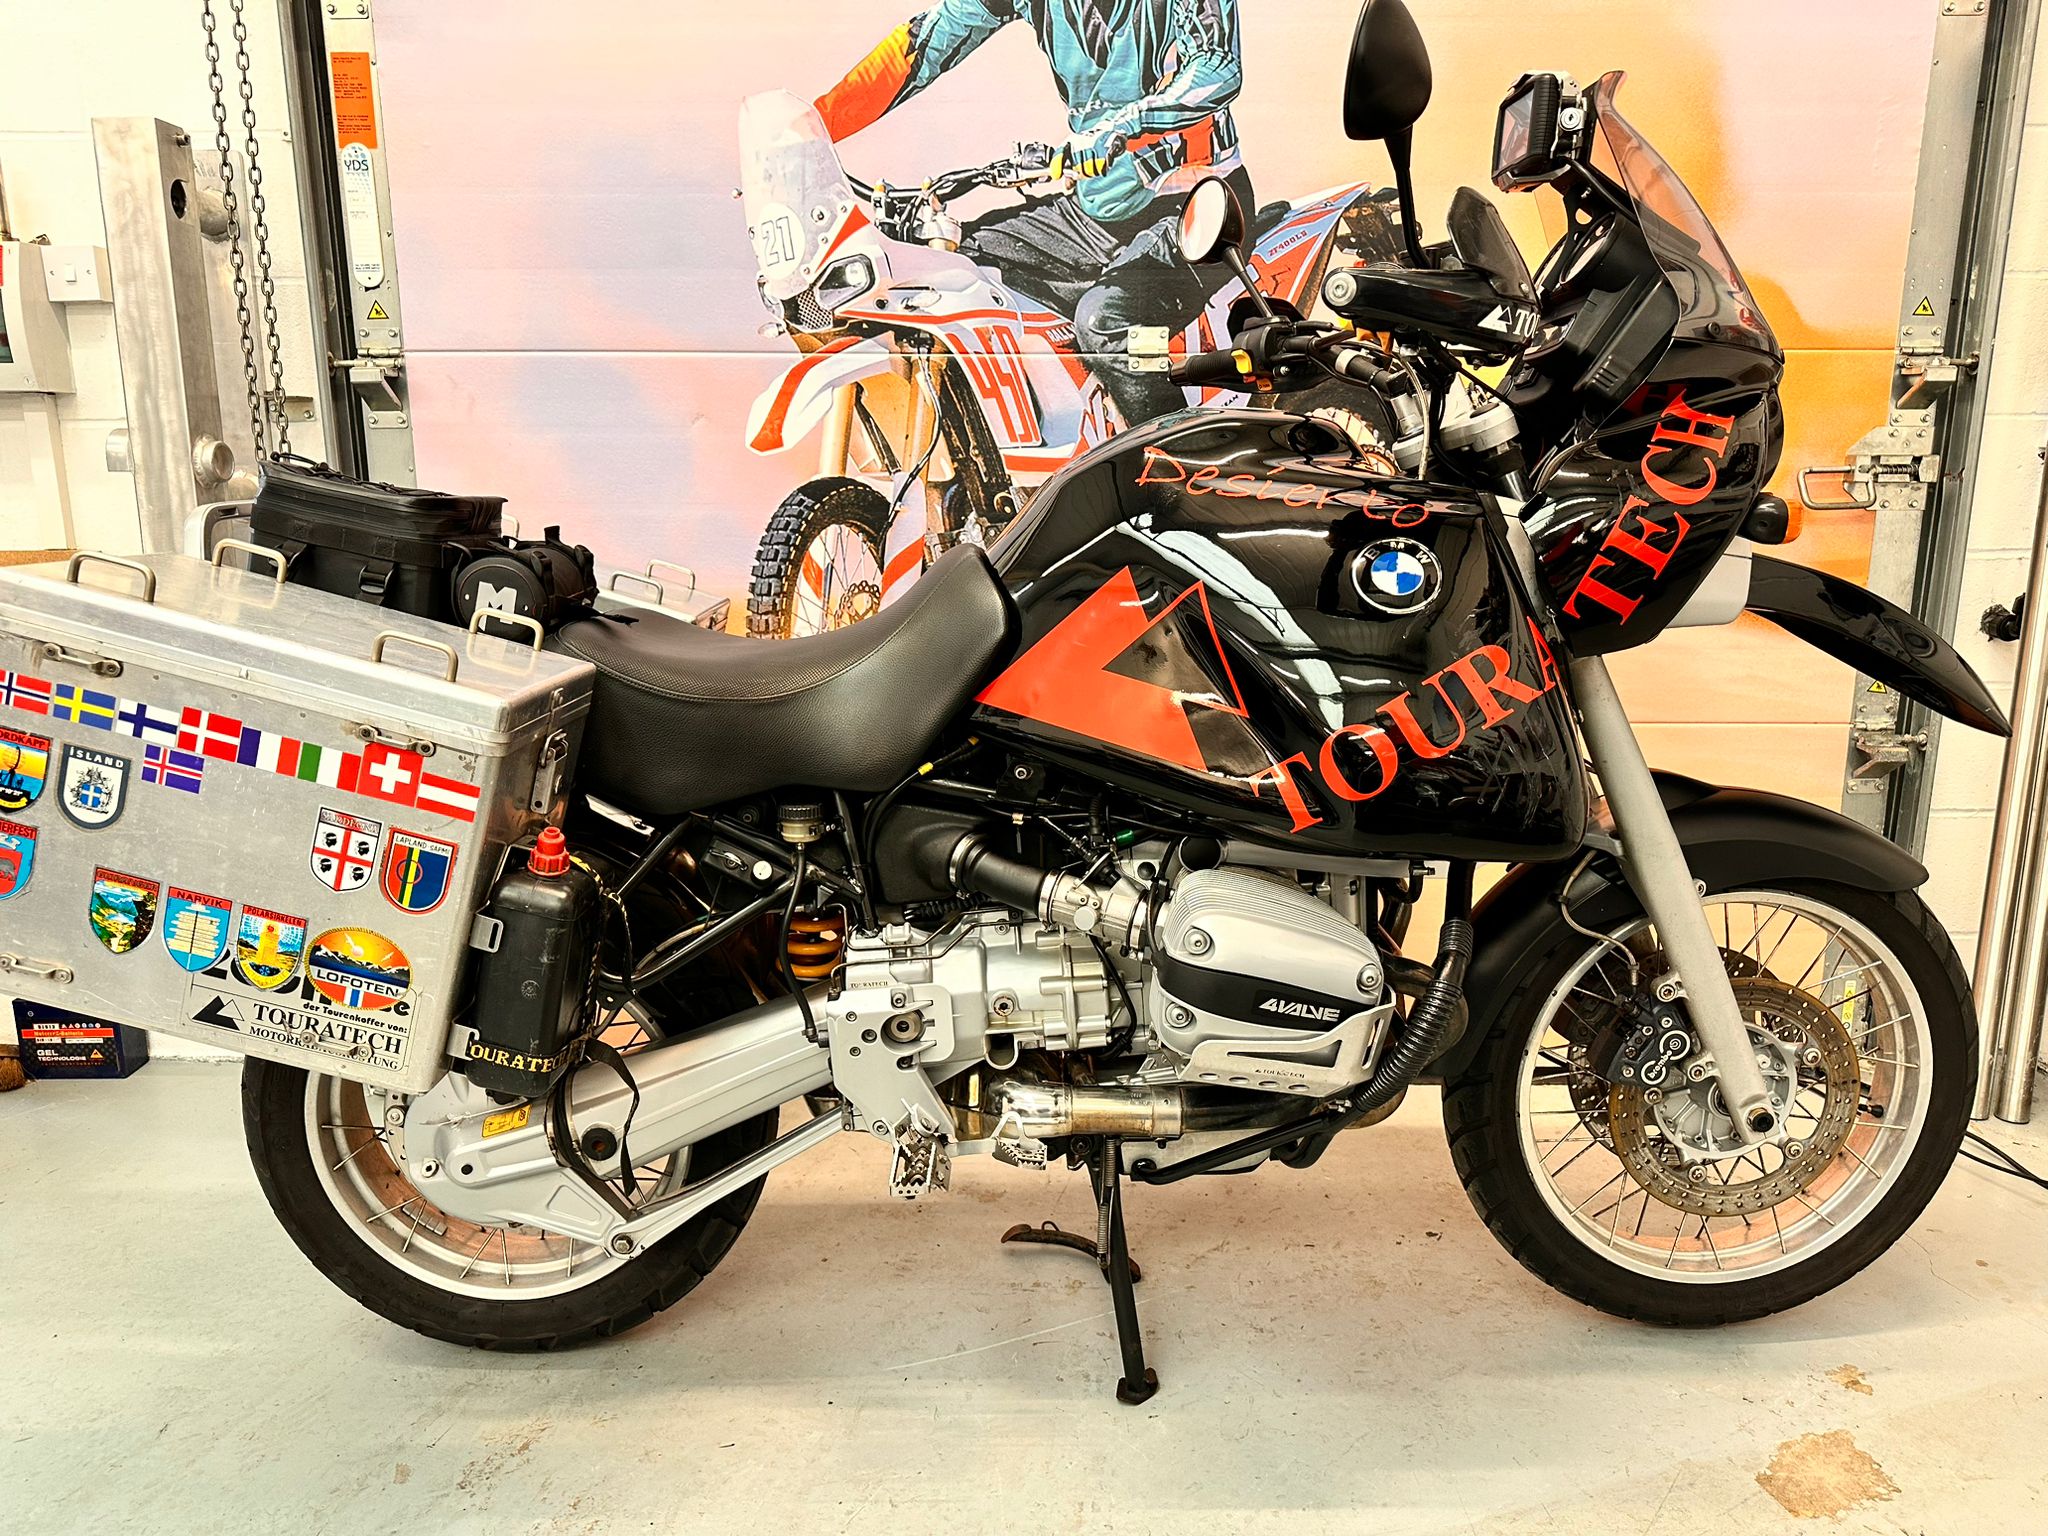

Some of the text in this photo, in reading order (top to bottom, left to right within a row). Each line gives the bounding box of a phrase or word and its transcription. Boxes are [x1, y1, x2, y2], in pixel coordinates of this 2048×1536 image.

[344, 160, 369, 171] YDS
[761, 215, 795, 267] 21
[1045, 323, 1076, 343] RALLY
[1134, 446, 1429, 527] Desierto
[1562, 388, 1735, 626] TECH
[1363, 541, 1432, 565] BMW
[1250, 616, 1560, 834] TOURA
[321, 811, 379, 833] SARDEGNA
[395, 834, 427, 849] LAPLAND
[176, 890, 223, 908] NARVIK
[315, 968, 399, 998] LOFOTEN
[303, 1001, 408, 1034] der Tourenkoffer von:
[1258, 998, 1341, 1022] 4VALVE
[253, 1002, 402, 1055] TOURATECH
[470, 1042, 567, 1073] OURATECH
[1646, 1049, 1673, 1079] brembo
